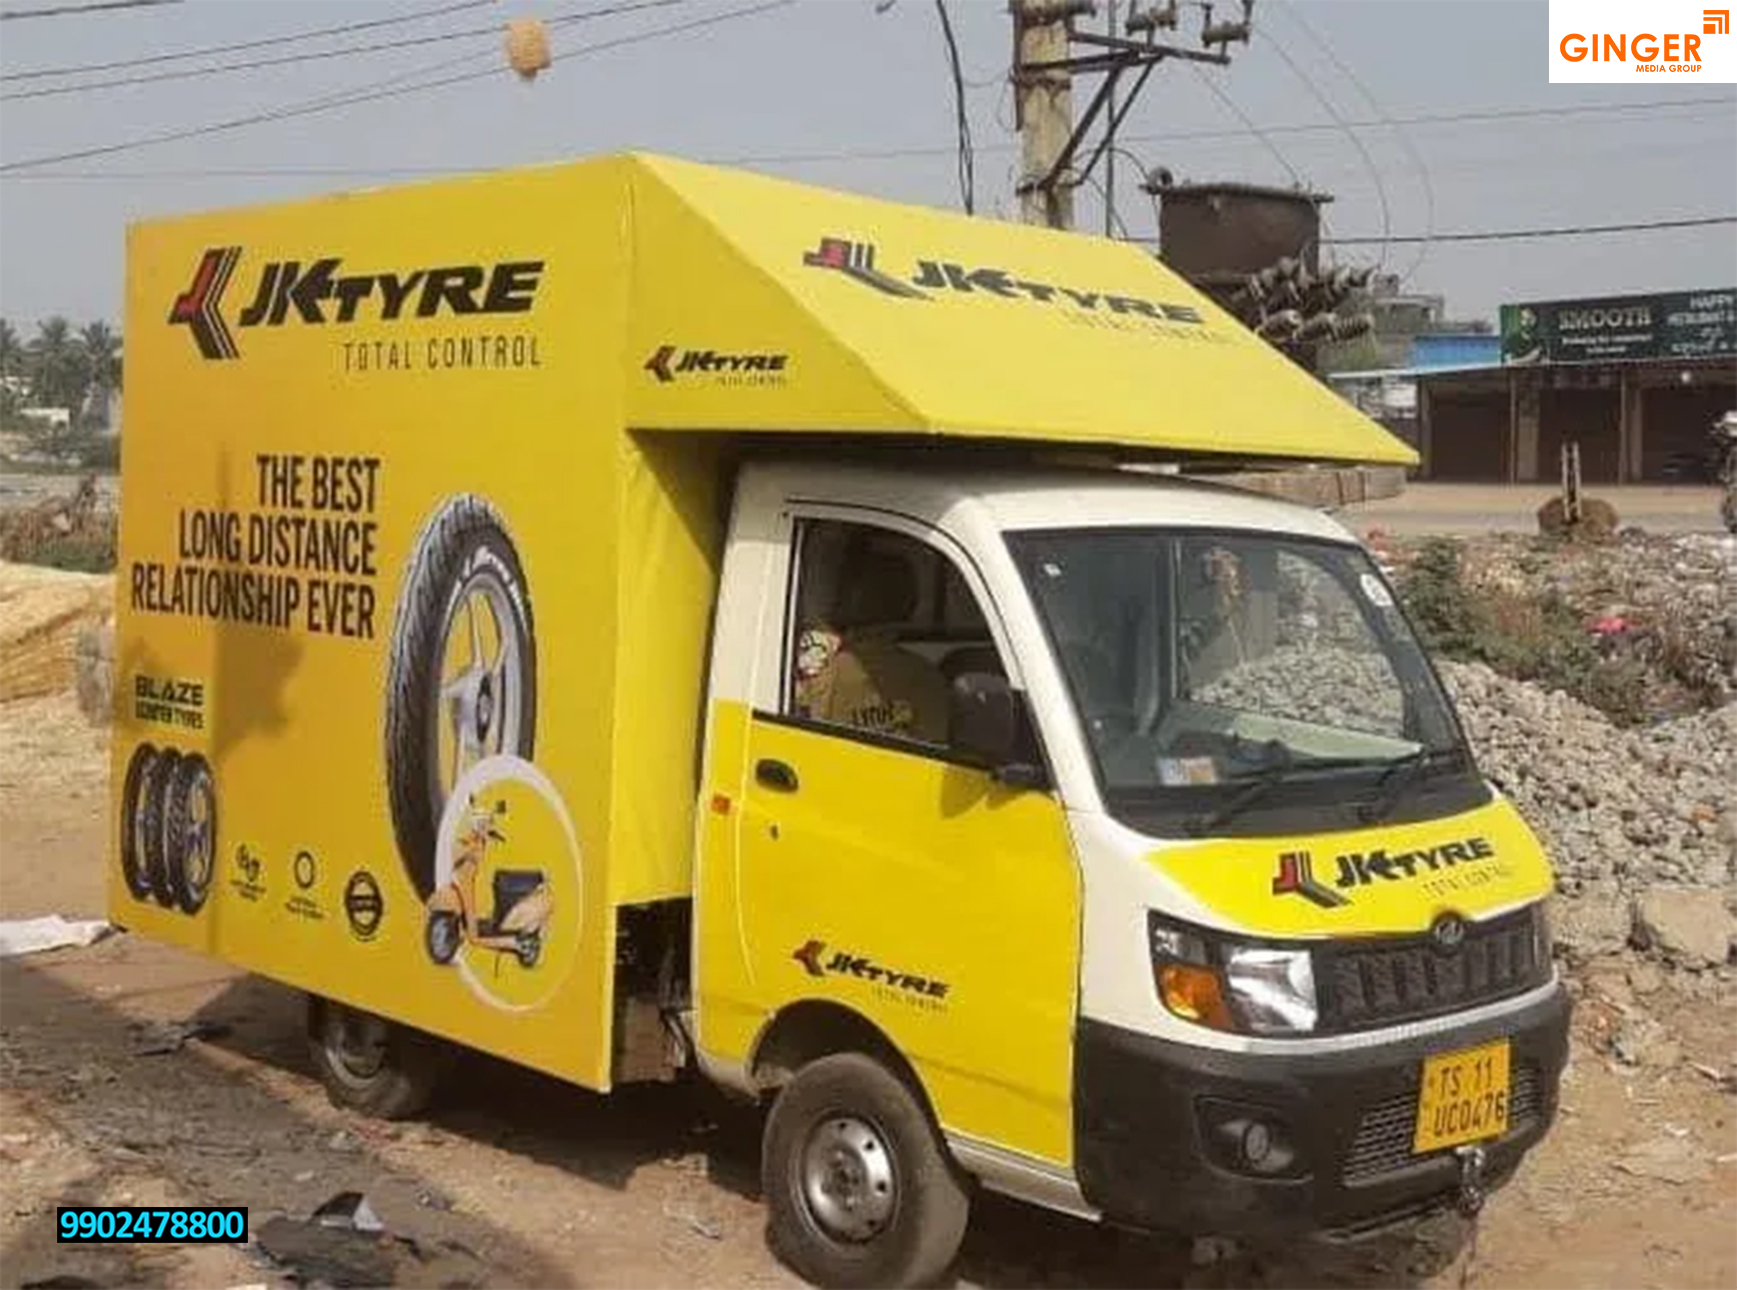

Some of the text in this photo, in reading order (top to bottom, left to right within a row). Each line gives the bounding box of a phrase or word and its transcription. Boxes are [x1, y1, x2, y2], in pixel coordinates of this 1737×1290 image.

[342, 334, 541, 371] TOTAL CONTROL
[256, 454, 380, 513] THE BEST
[179, 509, 377, 576] LONG DISTANCE
[131, 562, 299, 629] RELATIONSHIP
[307, 580, 376, 640] EVER
[136, 675, 203, 706] BLAZE
[1441, 1058, 1491, 1100] TS 11
